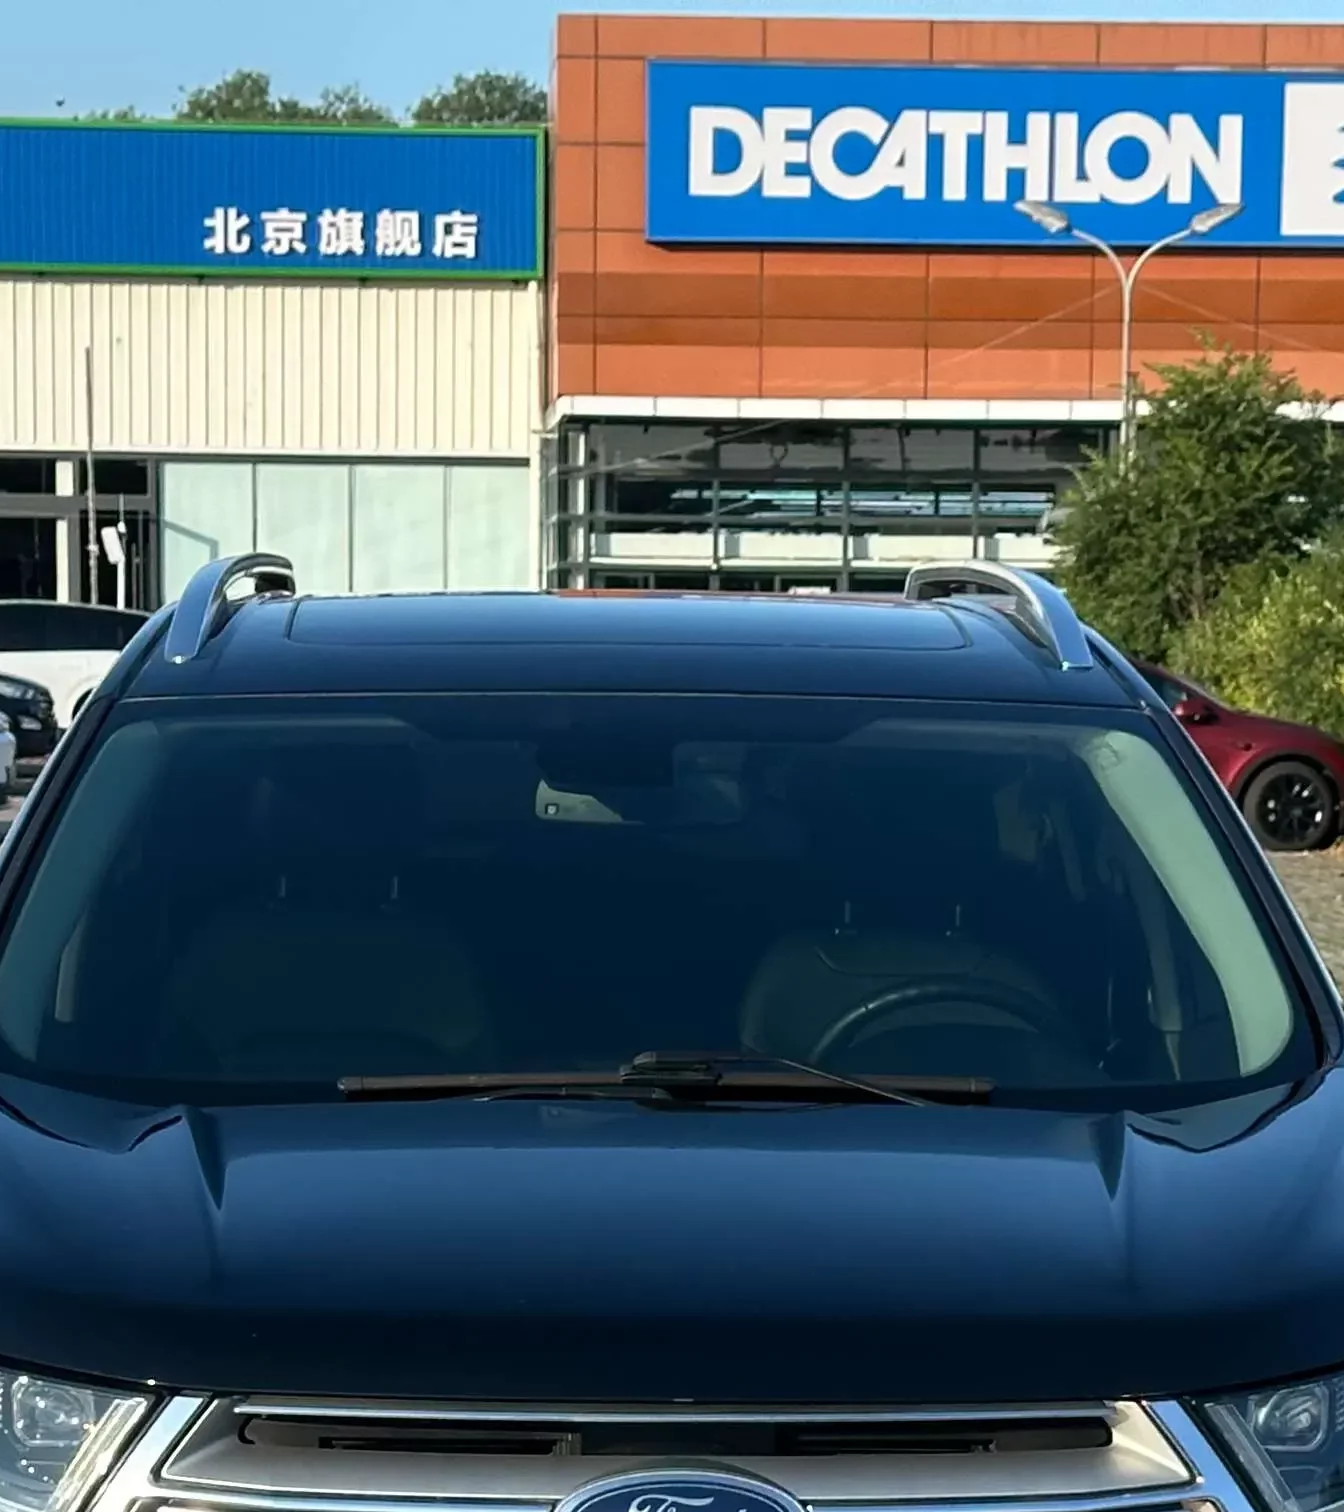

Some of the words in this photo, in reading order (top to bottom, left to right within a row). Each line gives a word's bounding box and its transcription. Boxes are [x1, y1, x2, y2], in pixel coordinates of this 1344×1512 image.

[689, 106, 1243, 204] DECATHLON
[203, 206, 478, 258] 北京旗舰店
